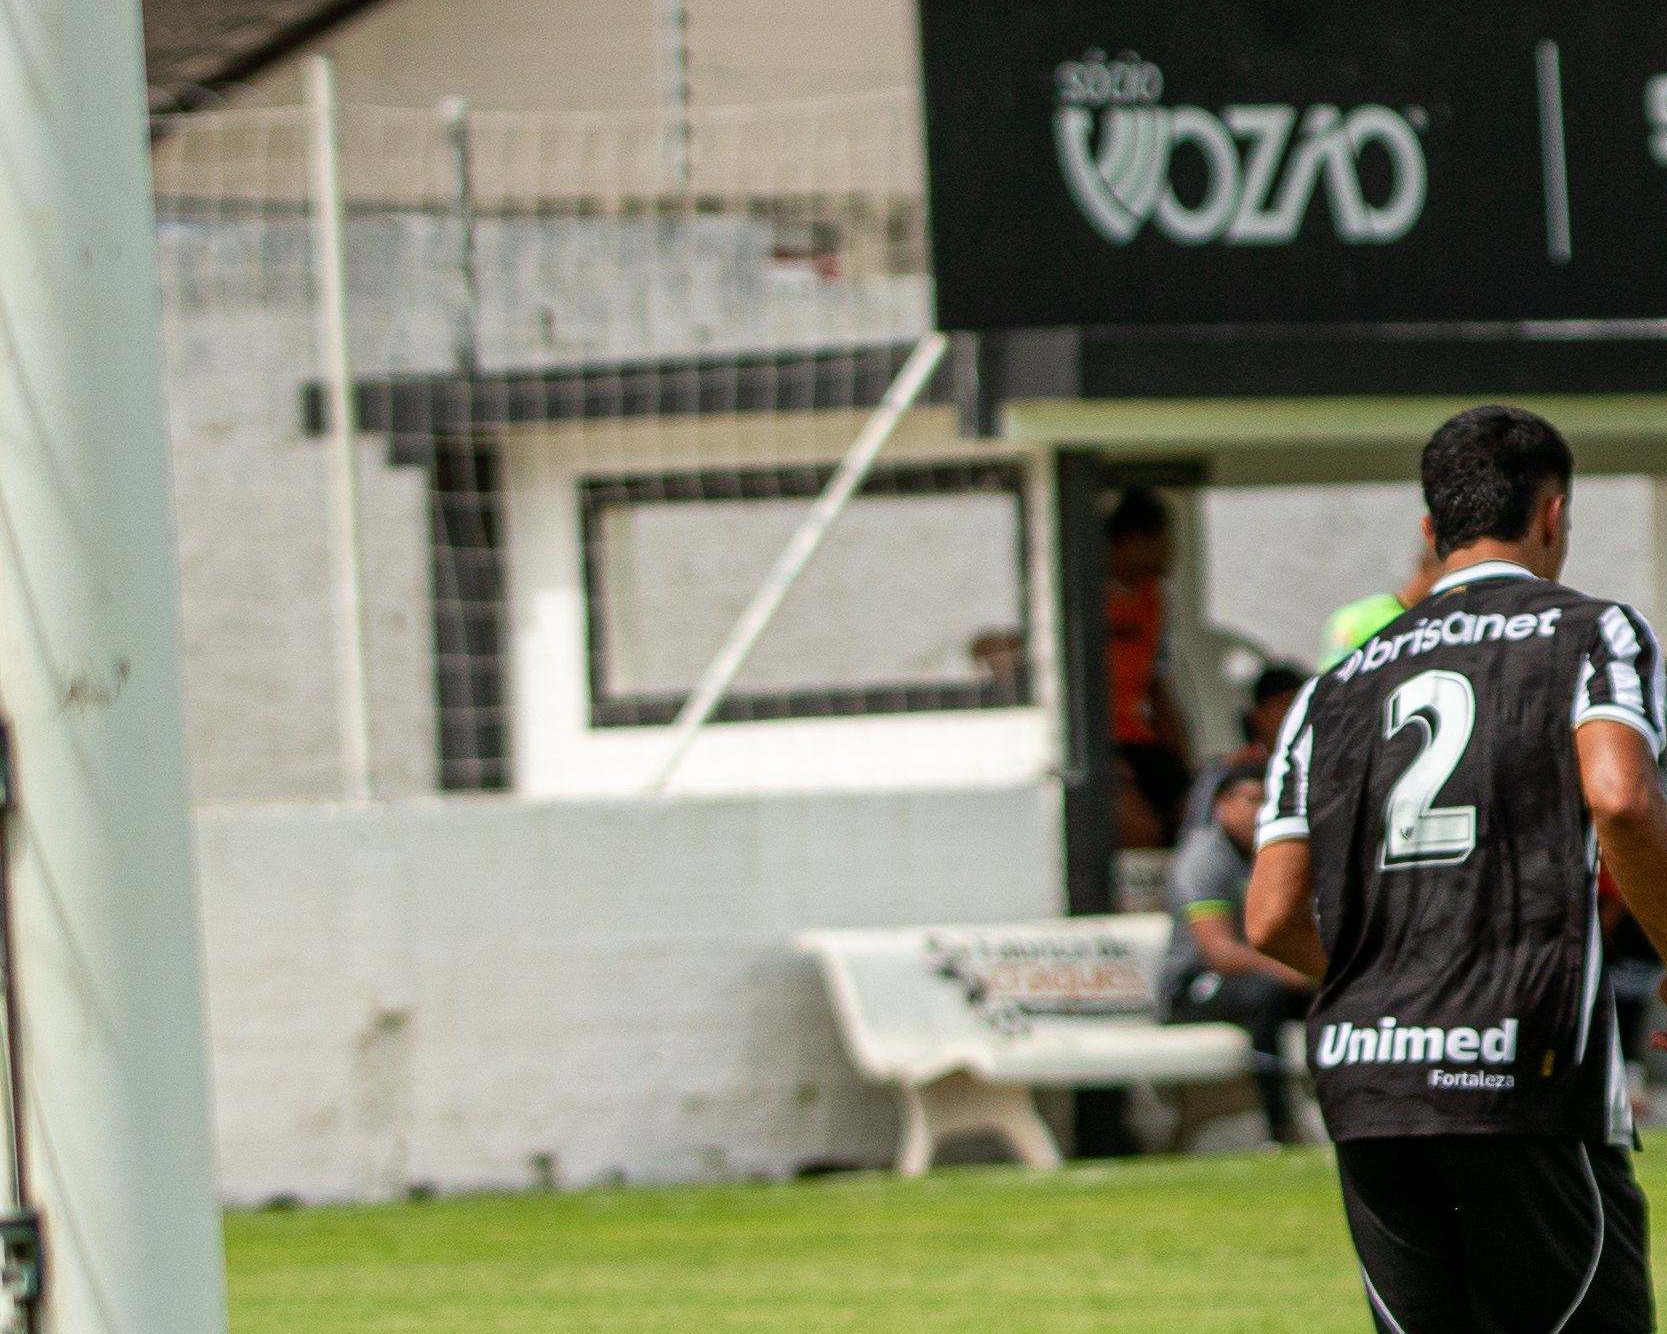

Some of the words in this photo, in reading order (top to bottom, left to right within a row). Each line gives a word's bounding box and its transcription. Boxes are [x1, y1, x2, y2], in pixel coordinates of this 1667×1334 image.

[1360, 608, 1562, 675] brisanet
[1377, 668, 1477, 873] 2
[1317, 1016, 1519, 1069] Unimed
[1428, 1069, 1515, 1091] Fortaleza
